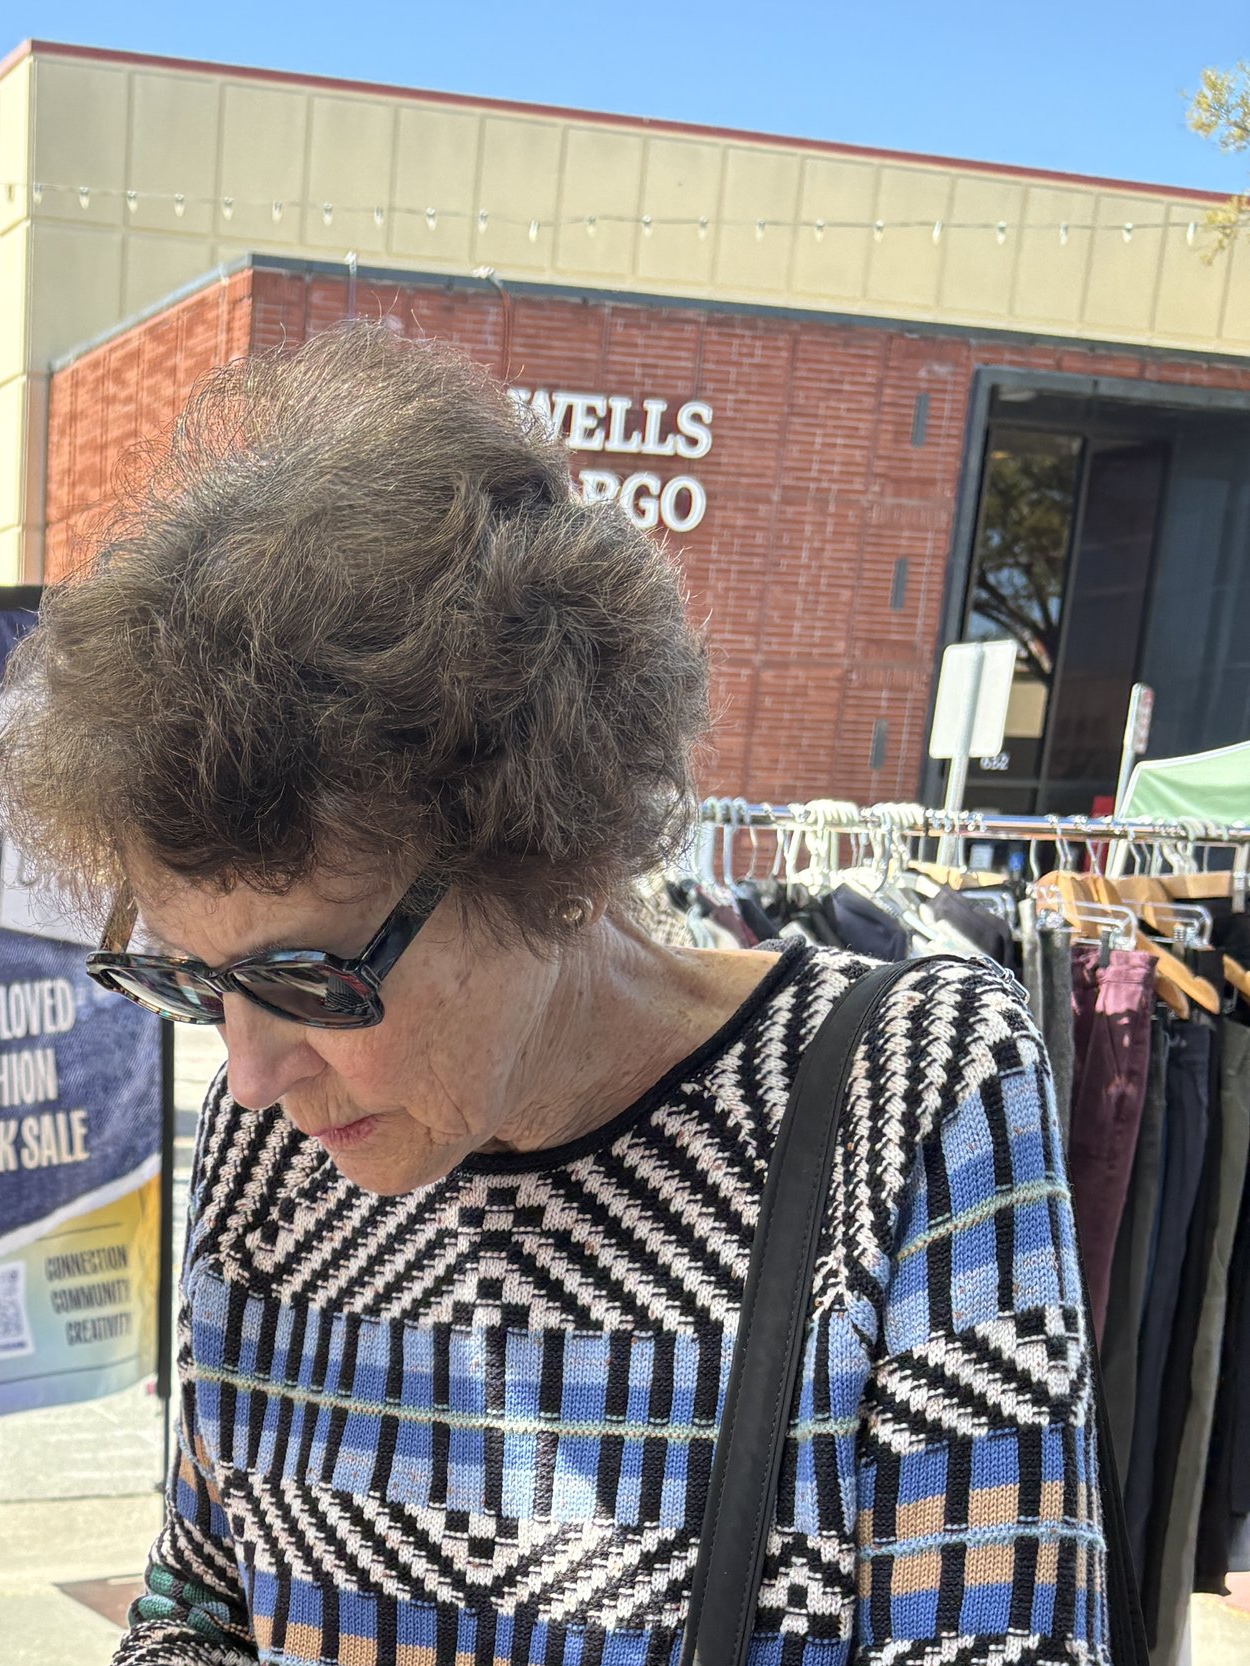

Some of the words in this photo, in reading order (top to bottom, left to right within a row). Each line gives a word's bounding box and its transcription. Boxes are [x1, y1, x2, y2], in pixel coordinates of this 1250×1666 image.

[507, 388, 713, 459] WELLS
[578, 468, 707, 533] RGO
[20, 1109, 91, 1170] SALE
[44, 1244, 128, 1282] CONNECTION
[50, 1278, 130, 1315] COMMUNITY
[65, 1311, 132, 1346] CREATIVITY
